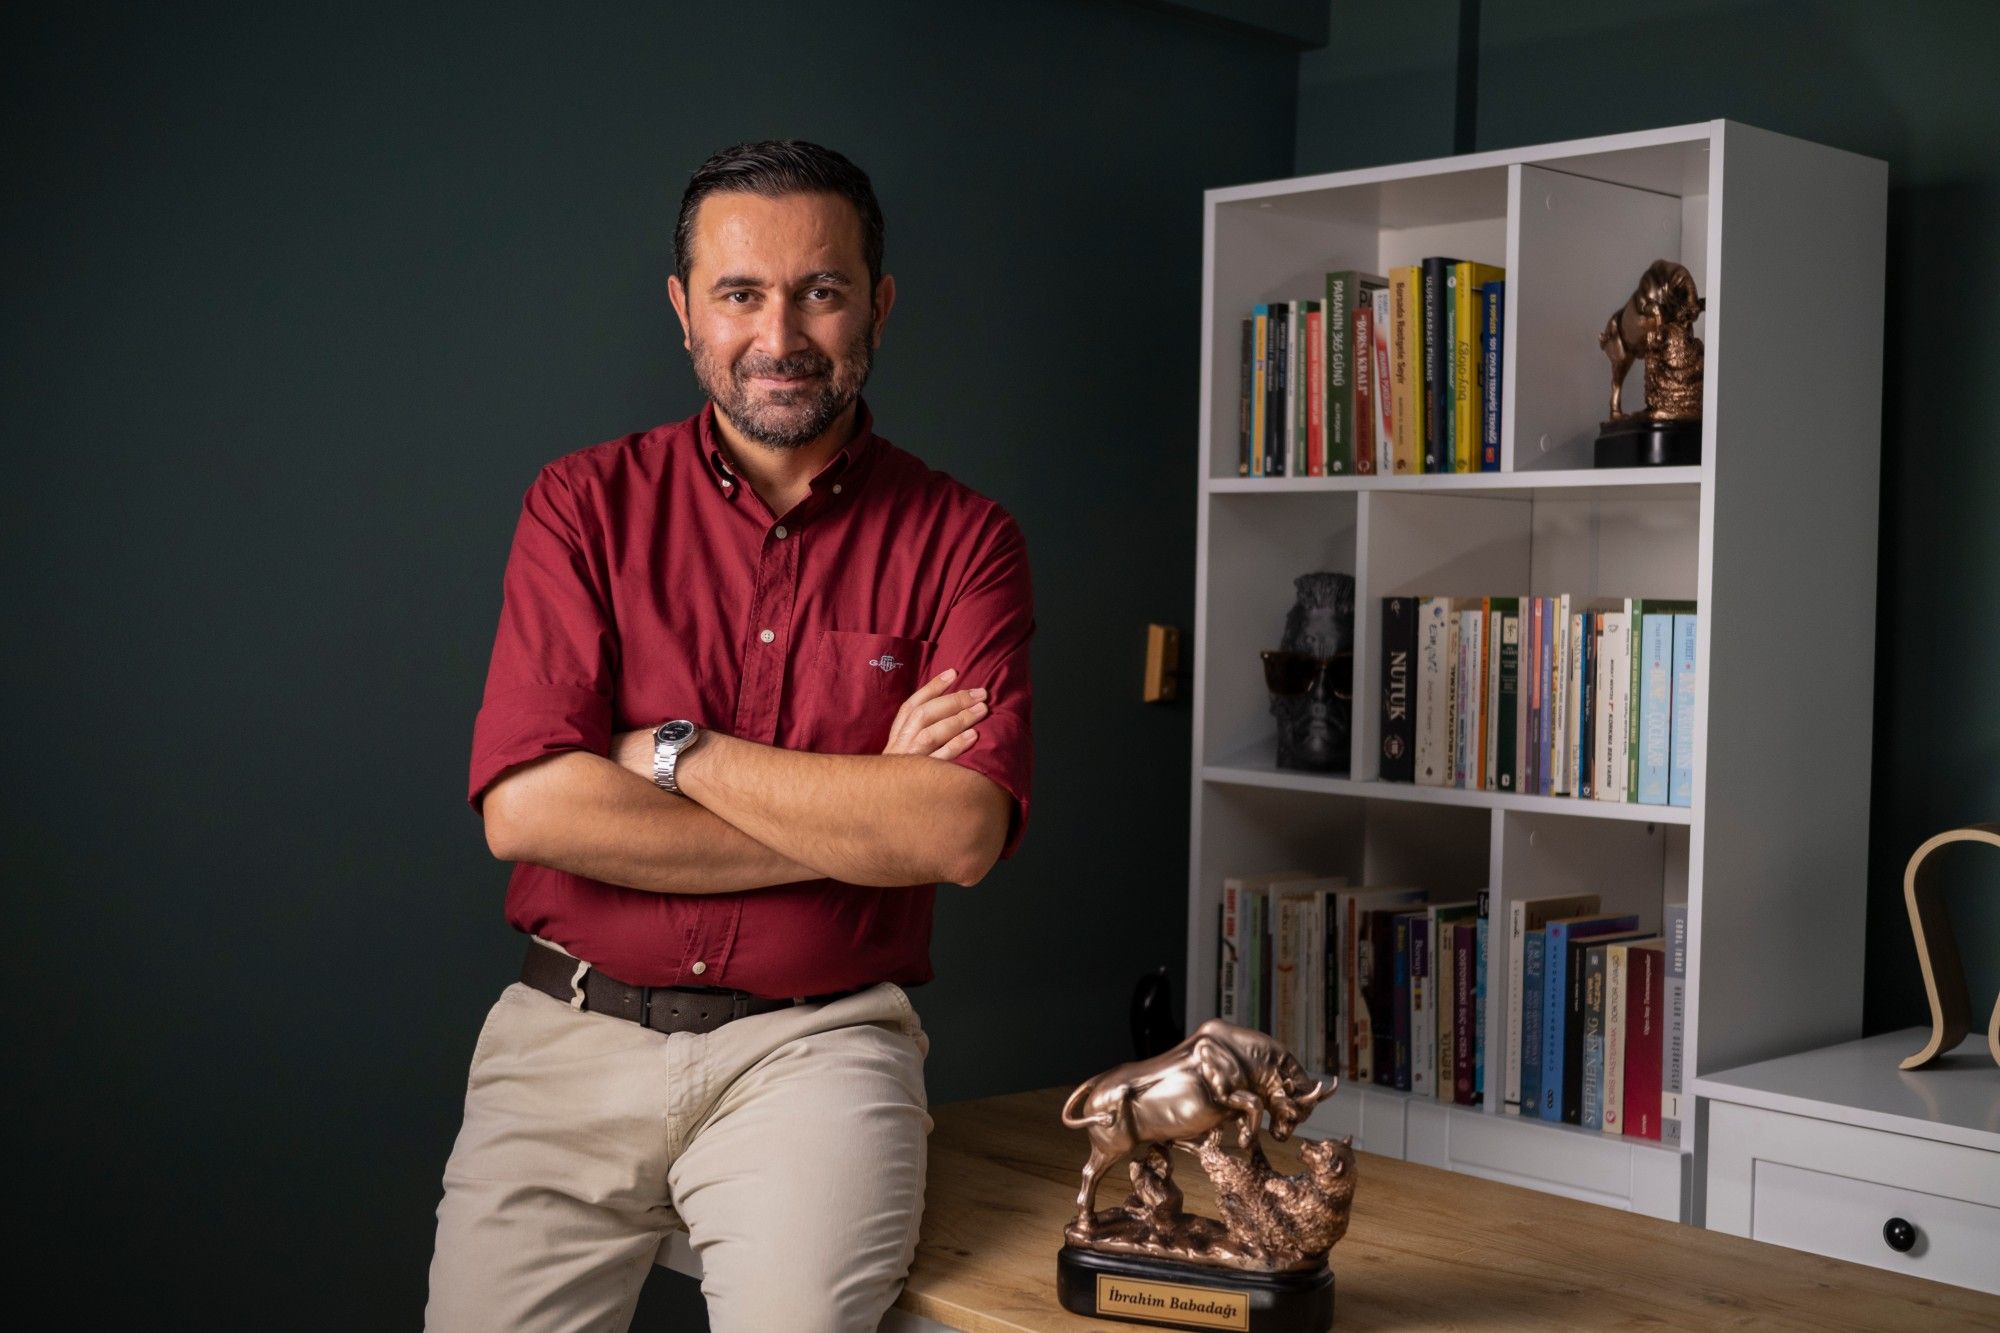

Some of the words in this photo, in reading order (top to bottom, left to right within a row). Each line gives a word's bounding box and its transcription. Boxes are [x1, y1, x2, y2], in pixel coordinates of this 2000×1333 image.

[1333, 281, 1344, 330] PARANIN
[1396, 282, 1405, 318] Borsada
[1395, 320, 1405, 359] Rastgele
[1333, 353, 1345, 387] GÜNÜ
[1396, 361, 1406, 384] Seyir
[1390, 651, 1407, 721] NUTUK
[1588, 1017, 1599, 1053] KING
[1585, 1058, 1597, 1123] STEPHEN
[1108, 1285, 1166, 1308] İbrahim
[1169, 1296, 1237, 1318] Babadağı
